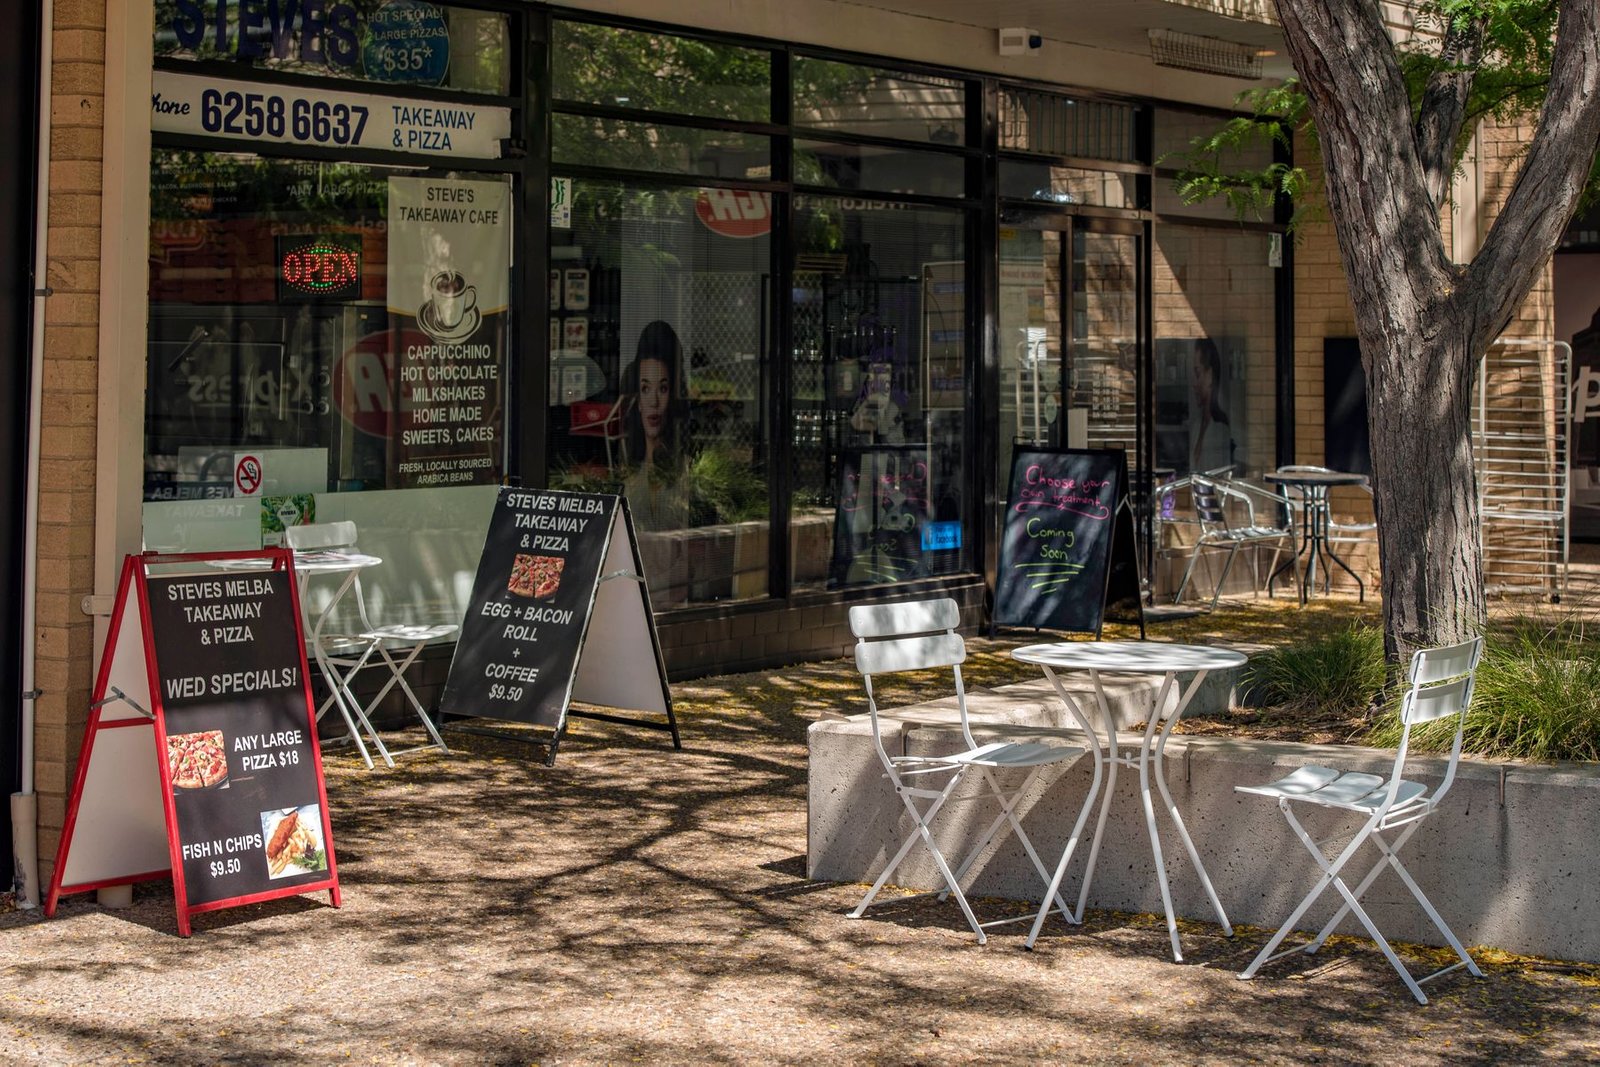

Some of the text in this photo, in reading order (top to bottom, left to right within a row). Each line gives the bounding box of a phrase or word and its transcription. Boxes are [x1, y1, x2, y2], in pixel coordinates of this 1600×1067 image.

[366, 8, 443, 23] HOT SPECIAL!
[173, 0, 359, 66] STEVES
[375, 29, 408, 40] LARGE
[201, 89, 285, 138] 6258
[292, 99, 369, 145] 6637
[392, 106, 475, 130] TAKEAWAY
[392, 129, 452, 150] & PIZZA
[427, 187, 474, 203] STEVE'S
[400, 207, 498, 224] TAKEAWAY CAFE
[284, 252, 358, 282] OPEN
[407, 345, 491, 360] CAPPUCCHINO
[401, 365, 497, 381] HOT CHOCOLATE
[412, 386, 486, 402] MILKSHAKES
[413, 407, 482, 423] HOME MADE
[402, 427, 494, 446] SWEETS, CAKES
[399, 458, 492, 474] FRESH, LOCALLY SOURCED
[417, 472, 473, 485] ARABICA BEANS
[1026, 464, 1110, 492] Choose your
[505, 493, 604, 514] STEVES MELBA
[1021, 488, 1101, 506] own treatment
[514, 513, 588, 533] TAKEAWAY
[1026, 517, 1075, 548] Coming
[520, 534, 569, 552] & PIZZA
[1040, 544, 1068, 560] Soon
[168, 578, 274, 601] STEVES MELBA
[184, 602, 262, 623] TAKEAWAY
[481, 602, 573, 625] EGG + BACON
[201, 625, 254, 645] & PIZZA
[503, 624, 538, 642] ROLL
[512, 648, 521, 658] +
[485, 662, 539, 683] COFFEE
[167, 667, 297, 699] WED SPECIALS!
[488, 684, 523, 701] $9.50
[234, 730, 302, 752] ANY LARGE
[242, 750, 299, 771] PIZZA $18
[182, 833, 263, 860] FISH N CHIPS
[210, 858, 241, 878] $9.50
